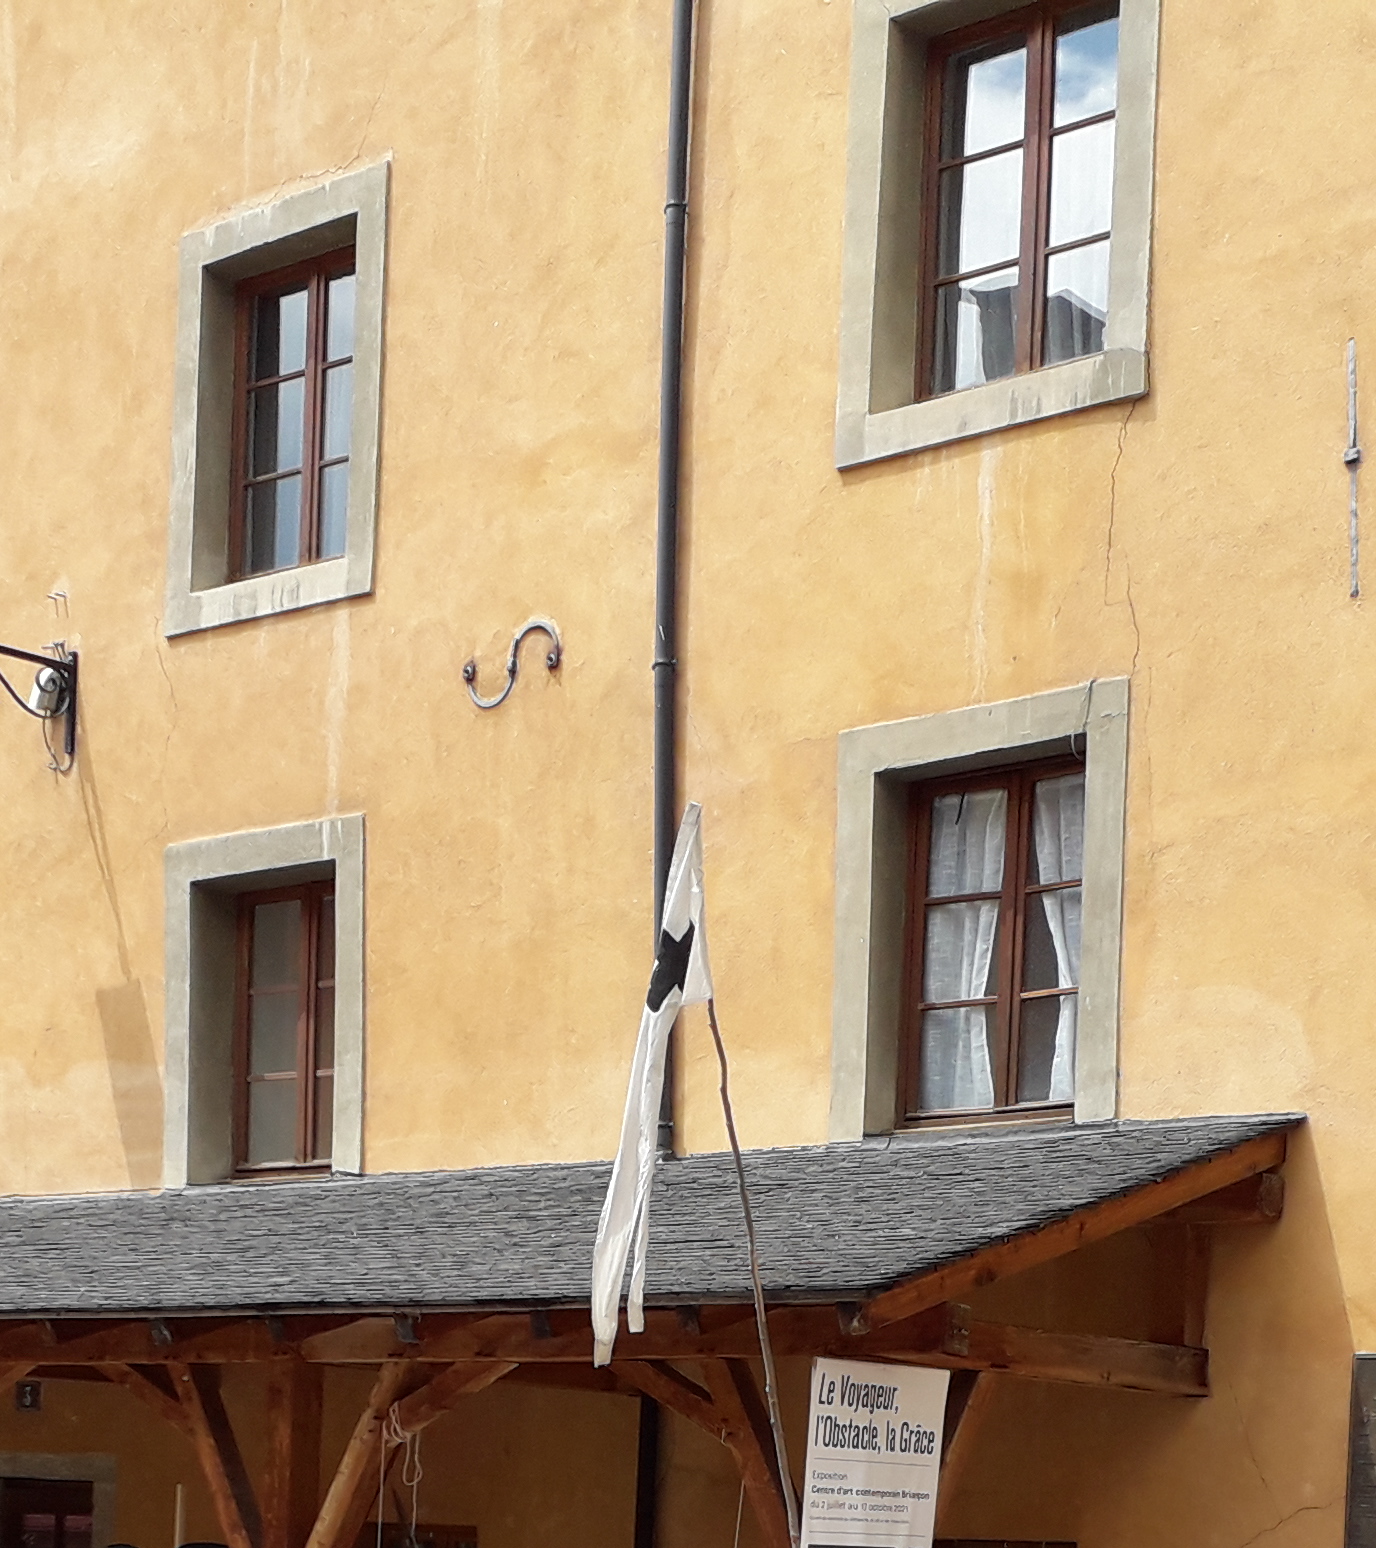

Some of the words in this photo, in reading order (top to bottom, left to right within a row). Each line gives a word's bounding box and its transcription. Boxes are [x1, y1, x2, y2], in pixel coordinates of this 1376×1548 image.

[818, 1371, 836, 1406] Le
[840, 1374, 899, 1415] Voyageur,
[814, 1414, 881, 1455] l'Obstacle,
[885, 1420, 896, 1452] la
[899, 1421, 935, 1455] Grâce
[812, 1470, 849, 1481] Exposition
[811, 1484, 836, 1495] Centre
[836, 1485, 854, 1496] d'art
[847, 1503, 858, 1511] au
